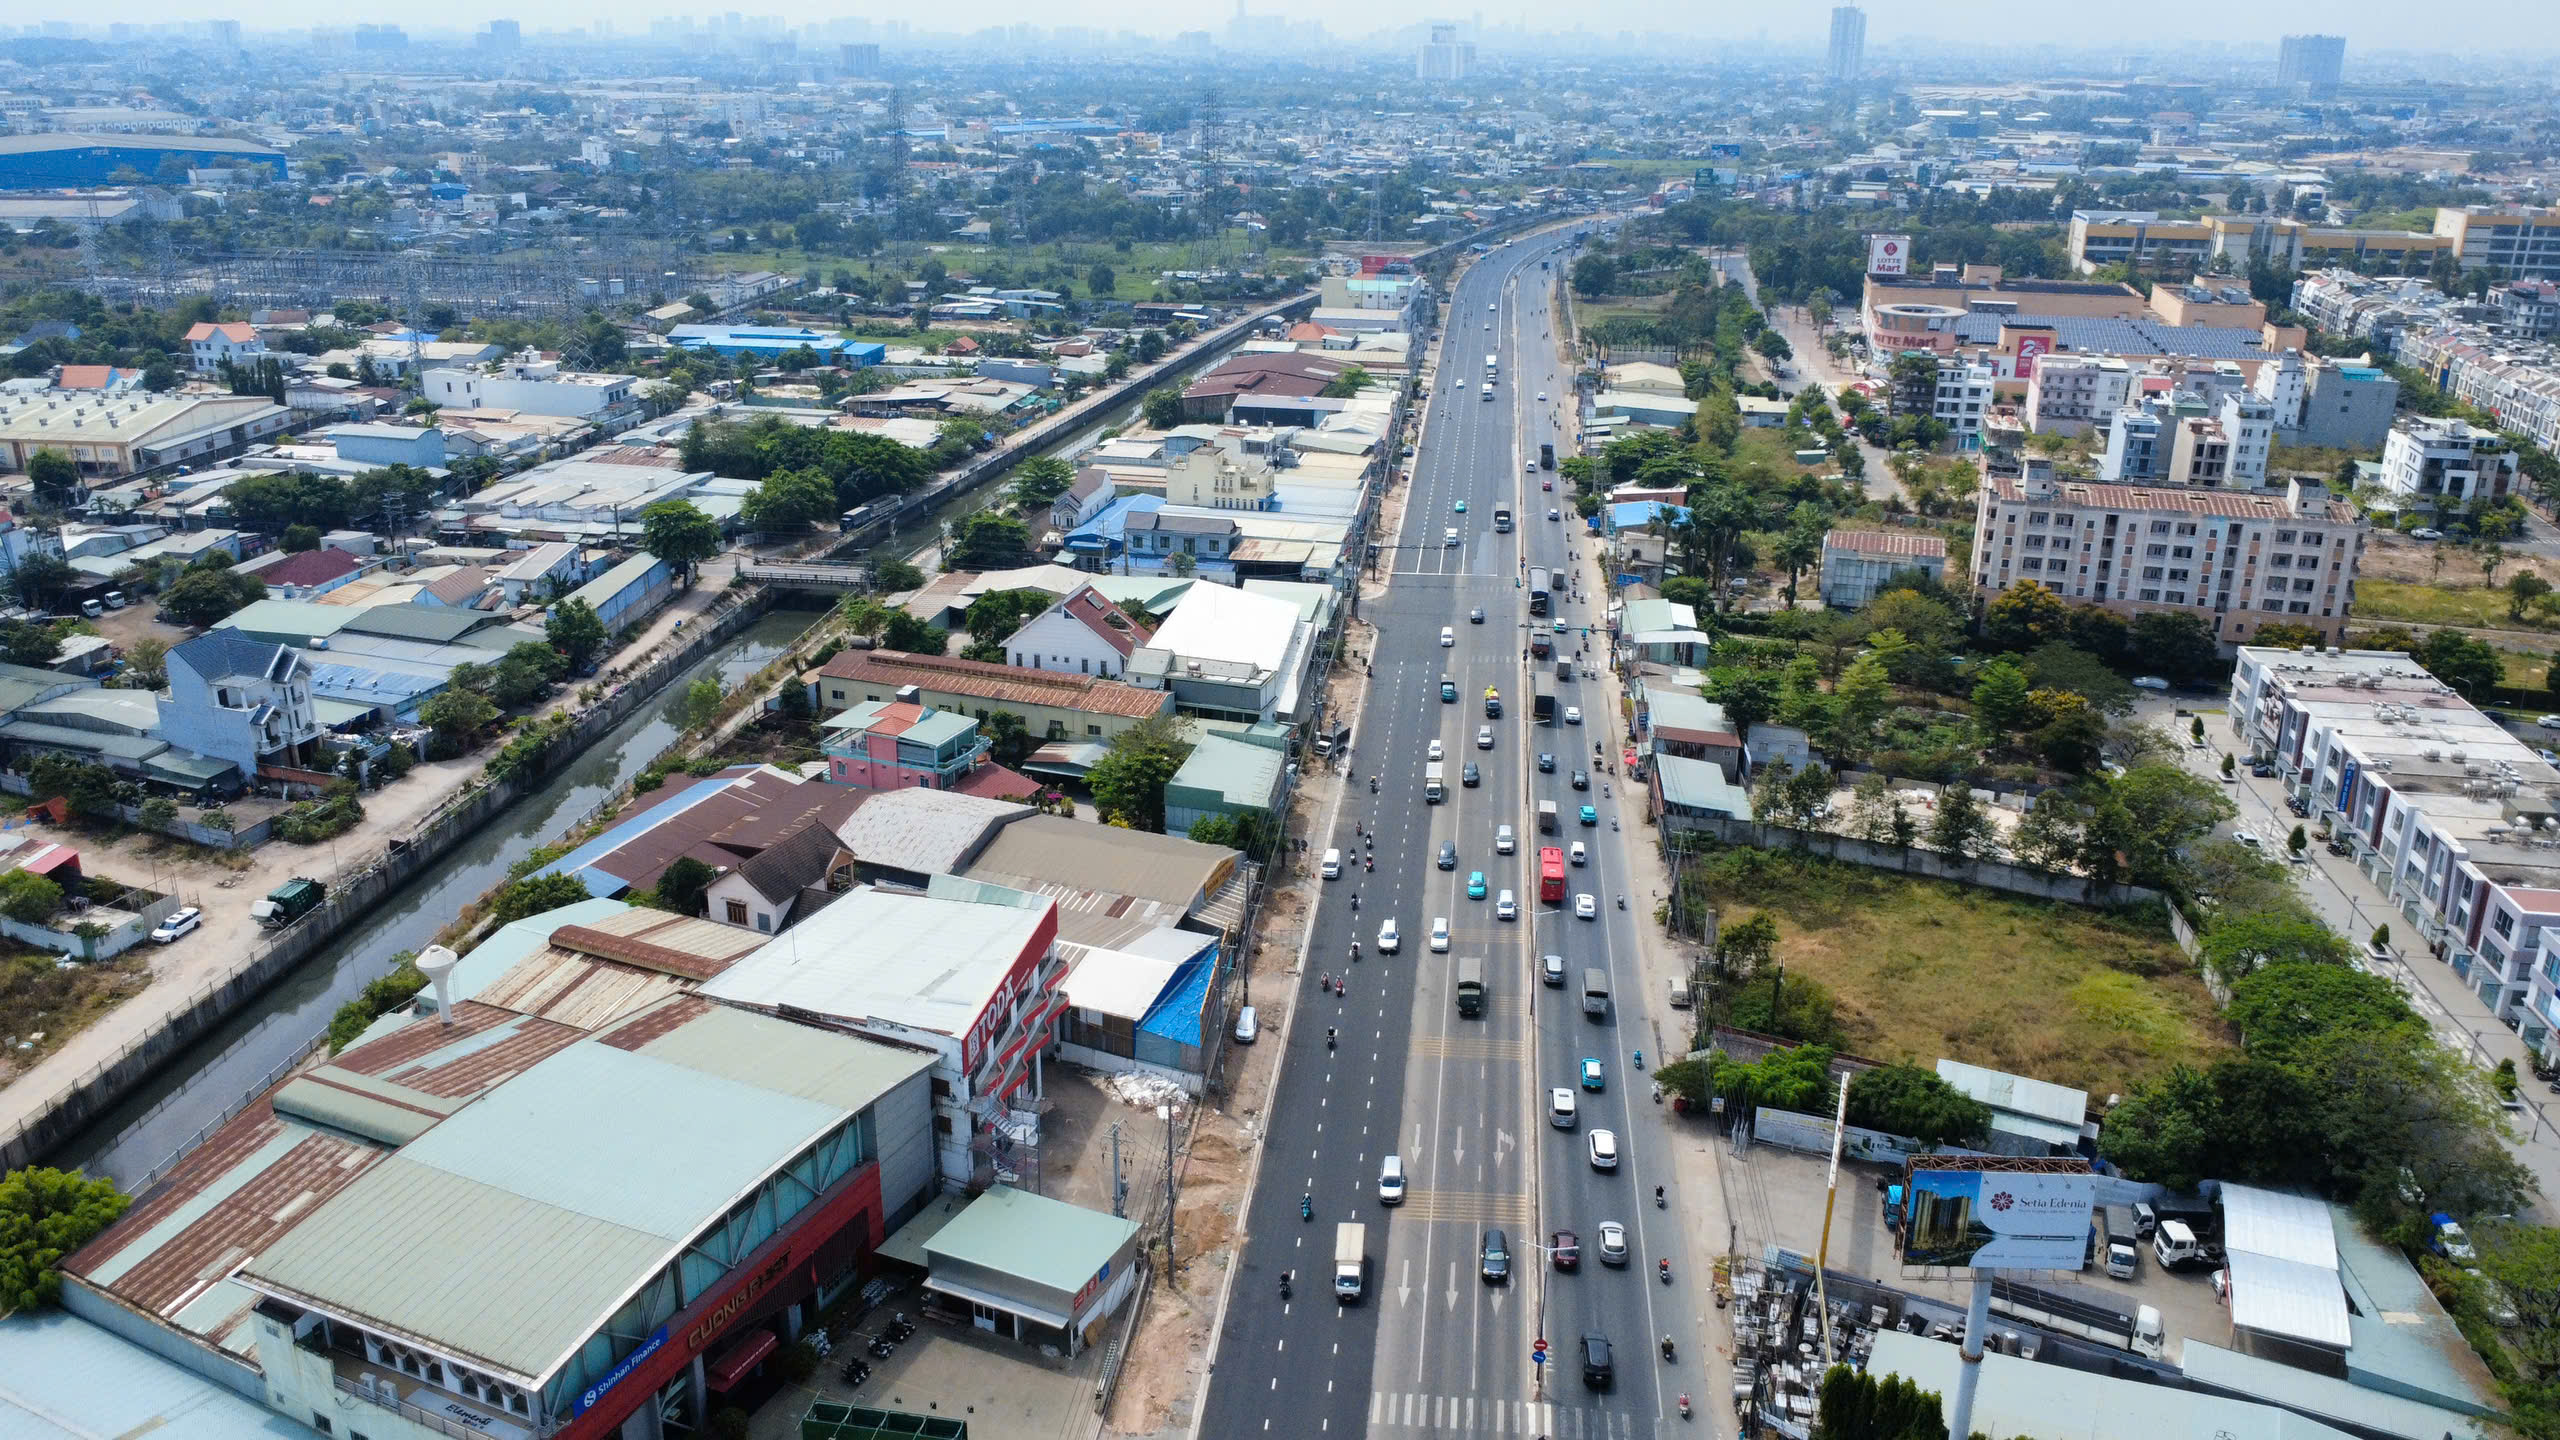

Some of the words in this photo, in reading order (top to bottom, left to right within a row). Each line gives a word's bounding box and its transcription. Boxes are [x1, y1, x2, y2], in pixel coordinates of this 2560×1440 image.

[1876, 264, 1901, 273] Mart
[1903, 335, 1938, 348] Mart
[2020, 1198, 2047, 1208] Setia
[2050, 1198, 2087, 1209] Edenia
[689, 1288, 747, 1348] CUONG
[598, 1364, 630, 1395] Shinhan
[632, 1339, 660, 1367] Finance
